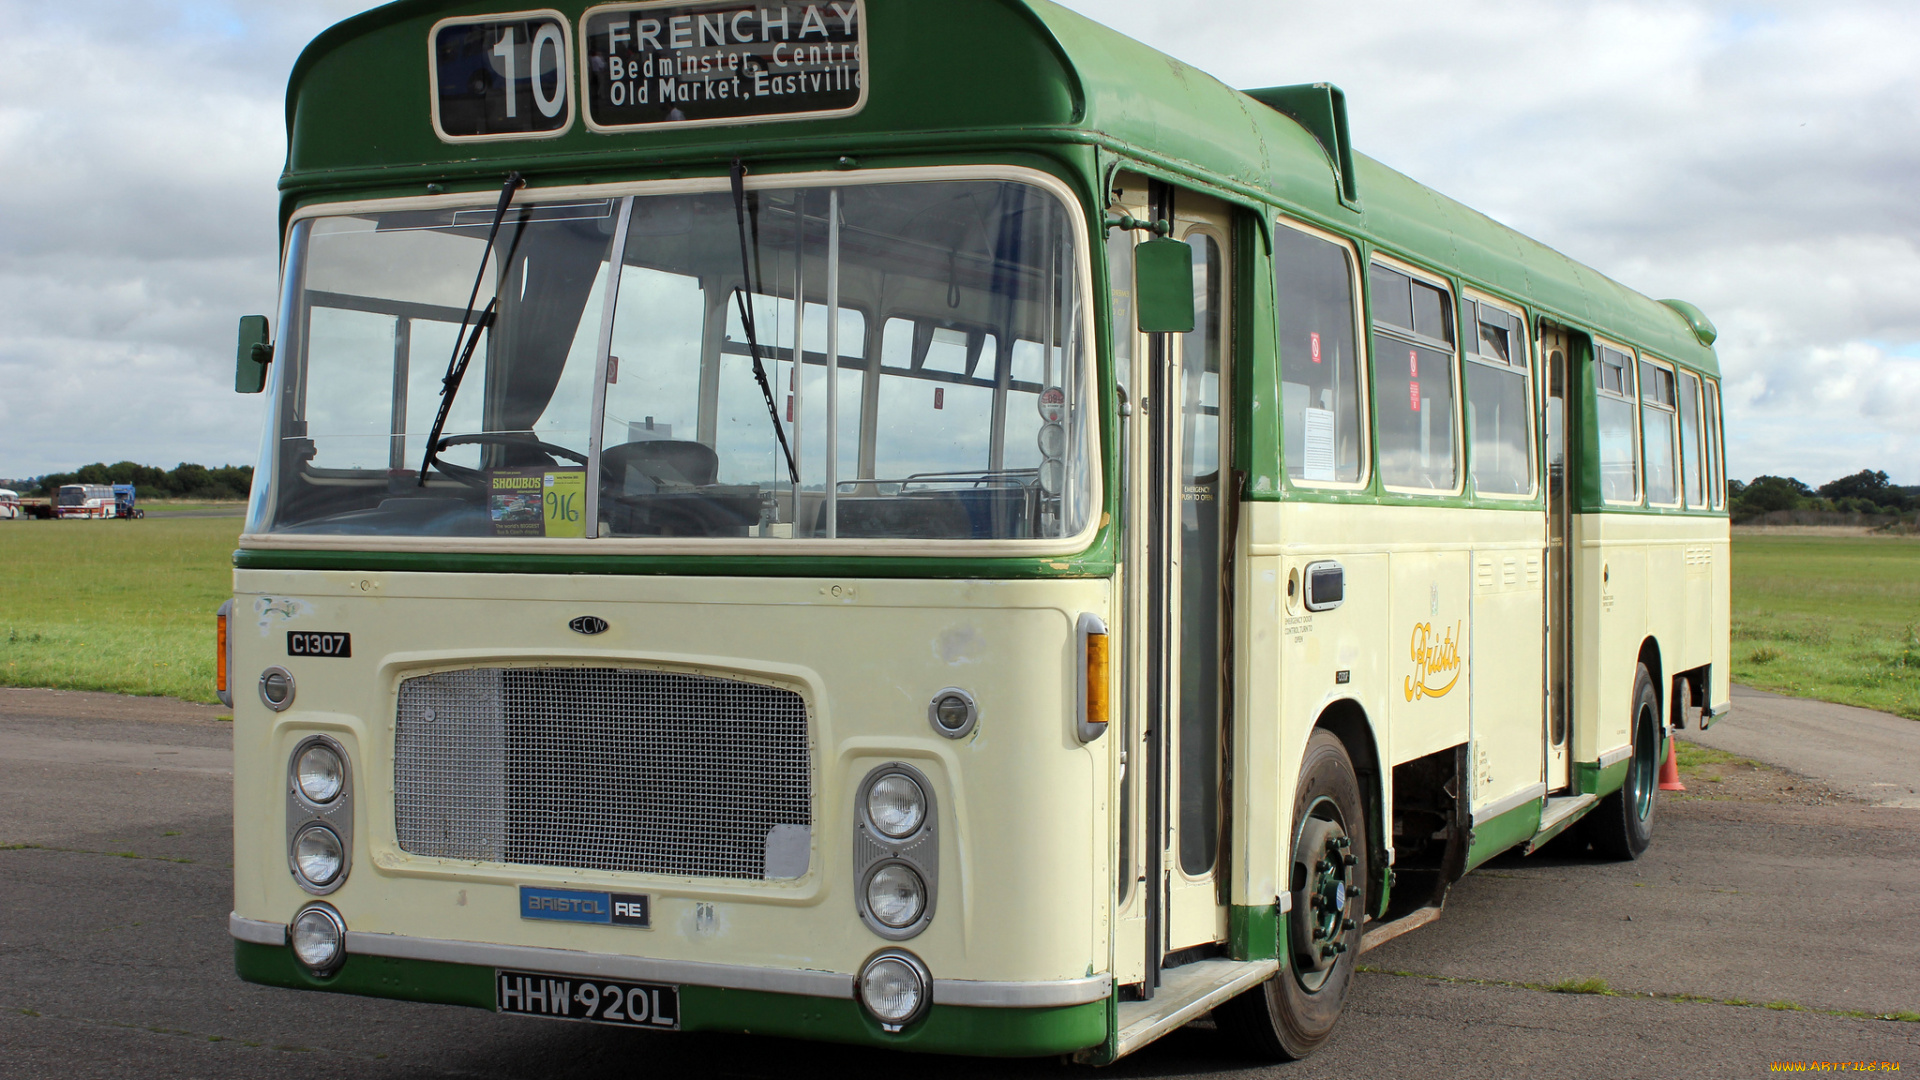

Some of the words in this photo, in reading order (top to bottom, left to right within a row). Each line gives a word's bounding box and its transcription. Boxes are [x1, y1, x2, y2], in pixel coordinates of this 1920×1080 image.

[609, 3, 858, 54] FRENCHAY
[494, 22, 566, 118] 10
[609, 50, 759, 80] Bedminster,
[610, 80, 648, 106] Old
[492, 477, 541, 489] SHOWBUS
[545, 491, 579, 522] 916
[572, 617, 605, 634] ECW
[292, 634, 345, 654] C1307
[1404, 619, 1461, 702] Bristol
[528, 896, 605, 915] BRISTOL
[615, 902, 641, 918] RE
[502, 975, 571, 1015] HHW
[578, 983, 674, 1025] 920L
